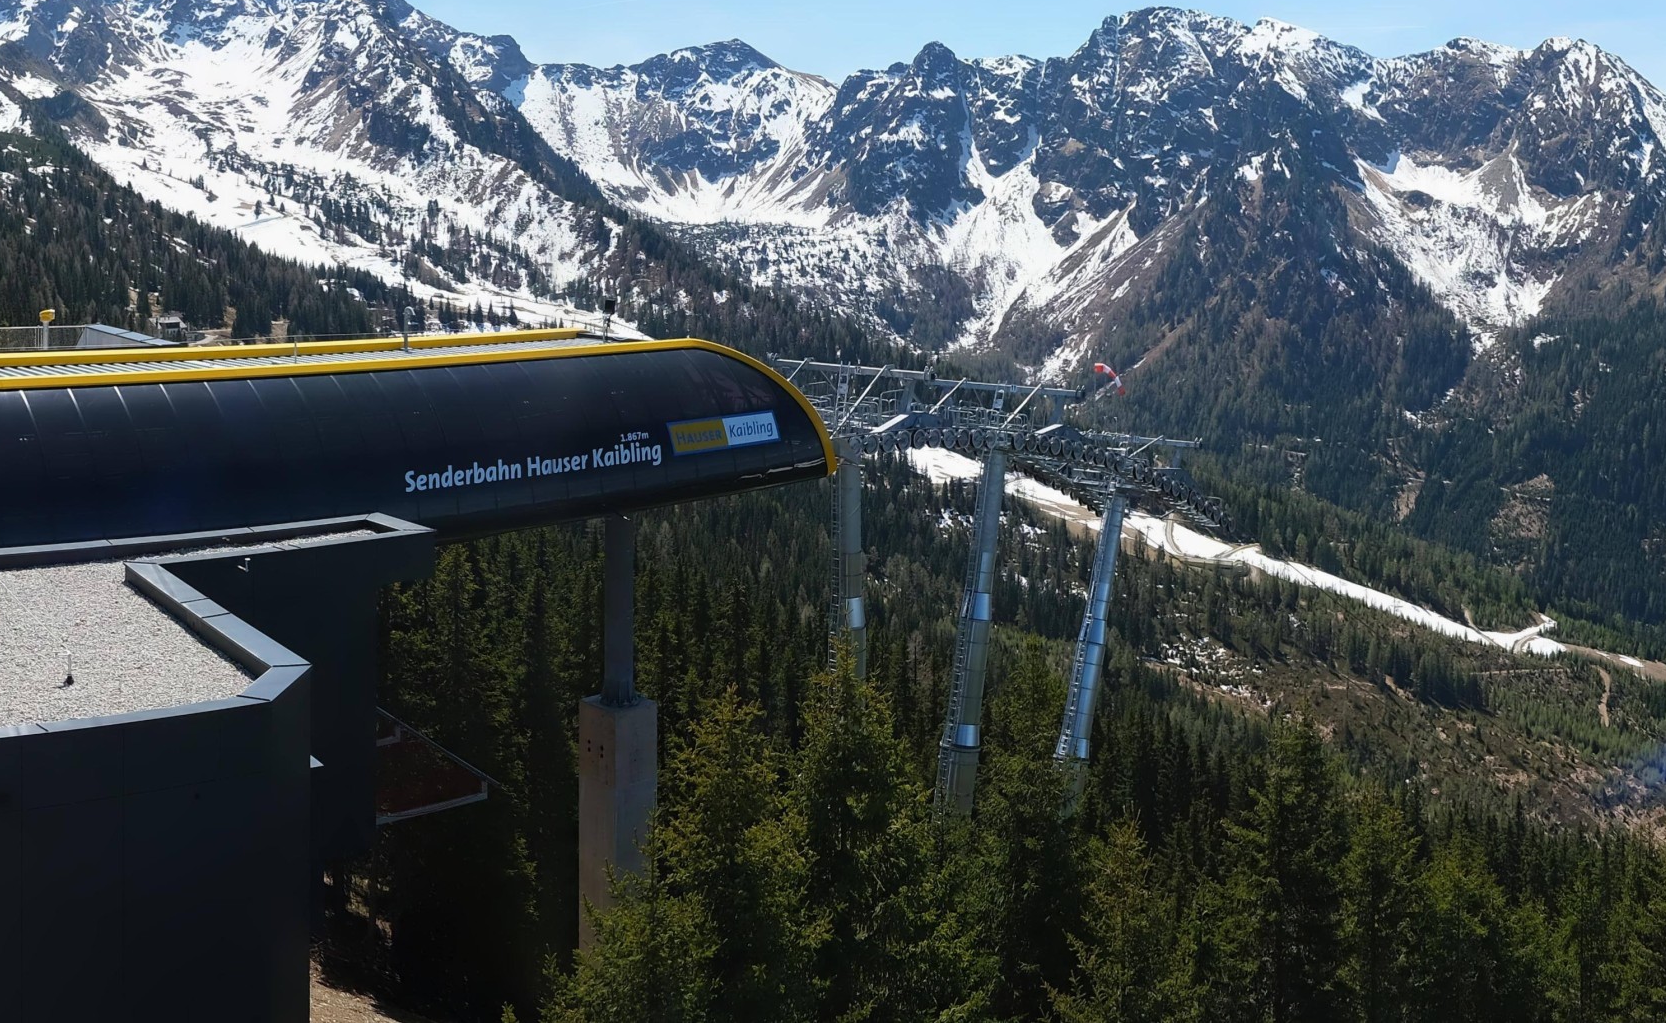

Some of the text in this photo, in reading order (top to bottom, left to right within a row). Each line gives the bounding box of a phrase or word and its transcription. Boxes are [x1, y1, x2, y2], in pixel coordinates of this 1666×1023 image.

[619, 430, 650, 443] 1.867m
[676, 421, 774, 446] HAUSER Kaibling
[404, 442, 663, 494] Senderbahn Hauser Kaibling
